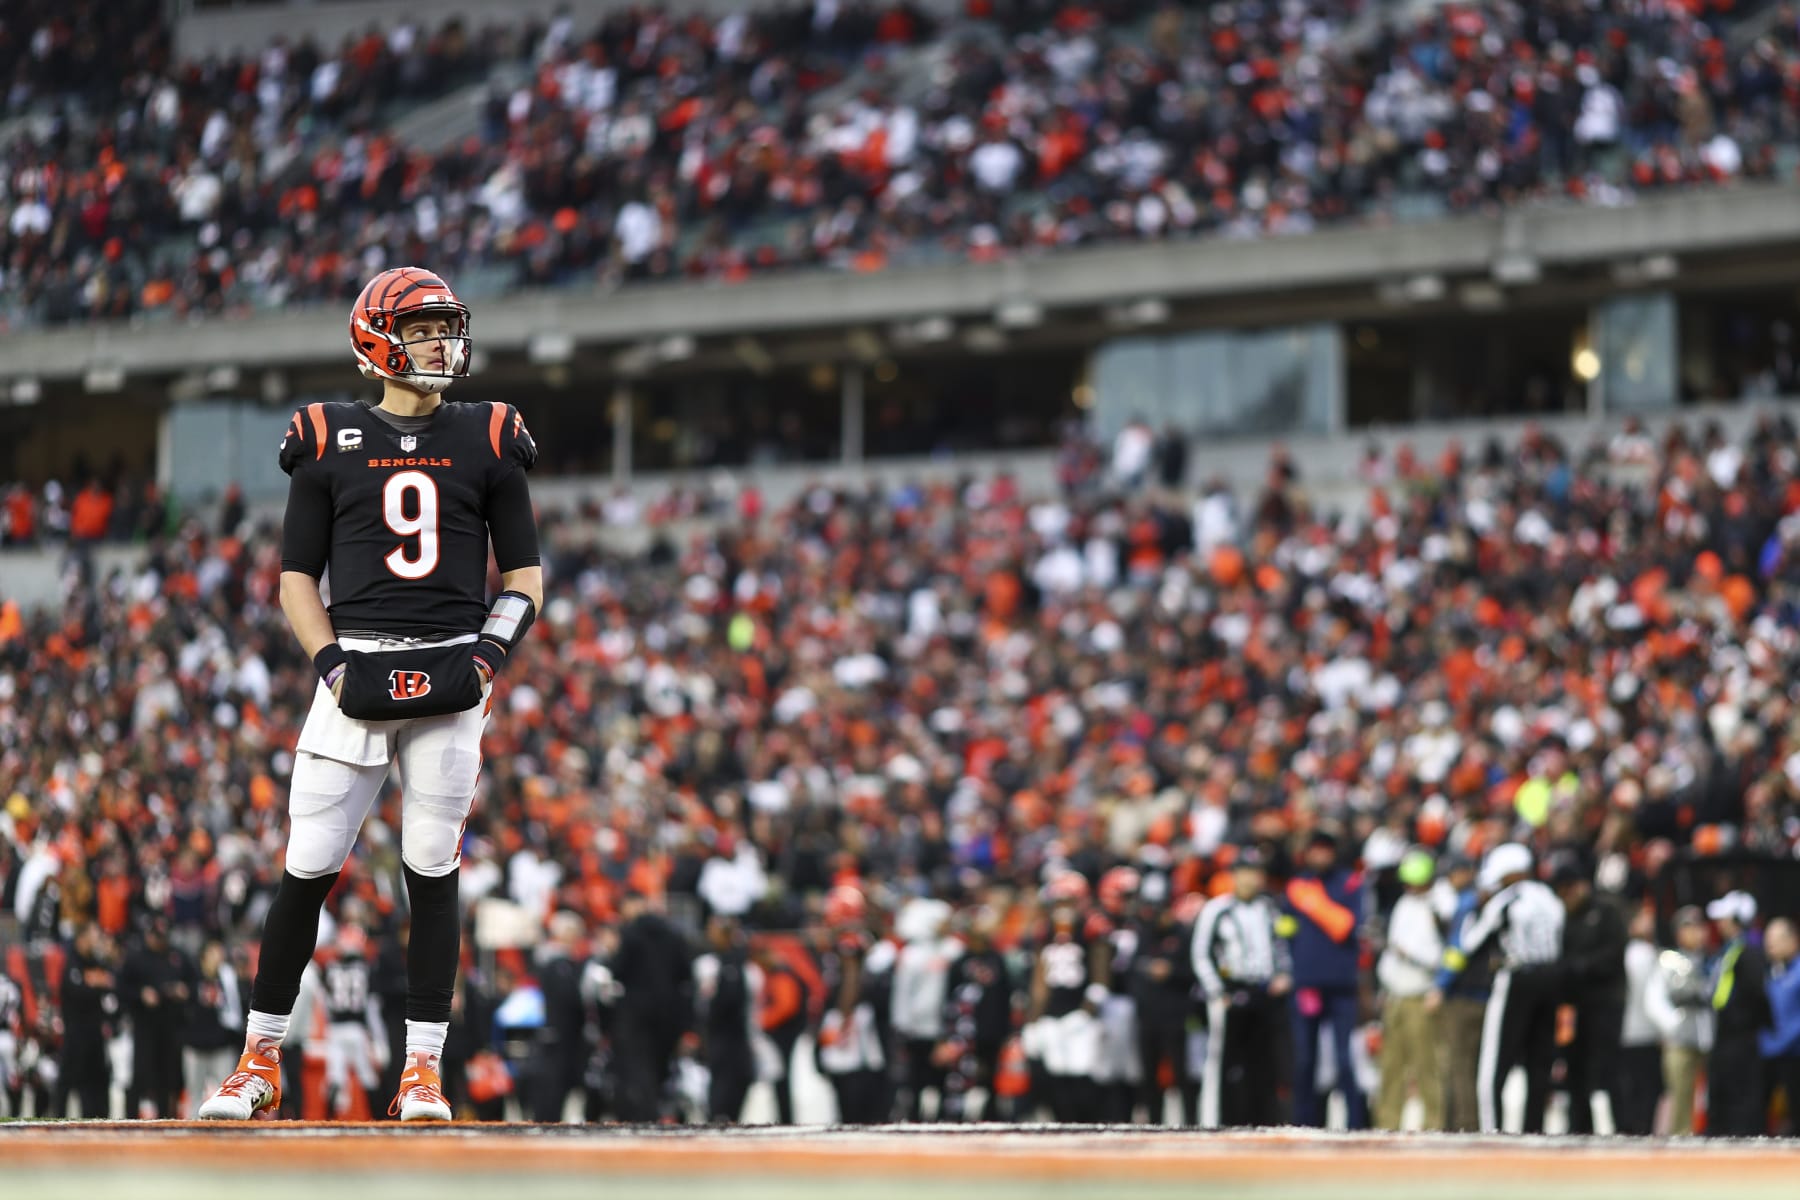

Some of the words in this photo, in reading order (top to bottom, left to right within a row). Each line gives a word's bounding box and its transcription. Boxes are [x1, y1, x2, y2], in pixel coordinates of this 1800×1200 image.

[337, 428, 362, 446] C
[367, 457, 452, 467] BENGALS
[383, 469, 439, 580] 9
[388, 669, 431, 700] B
